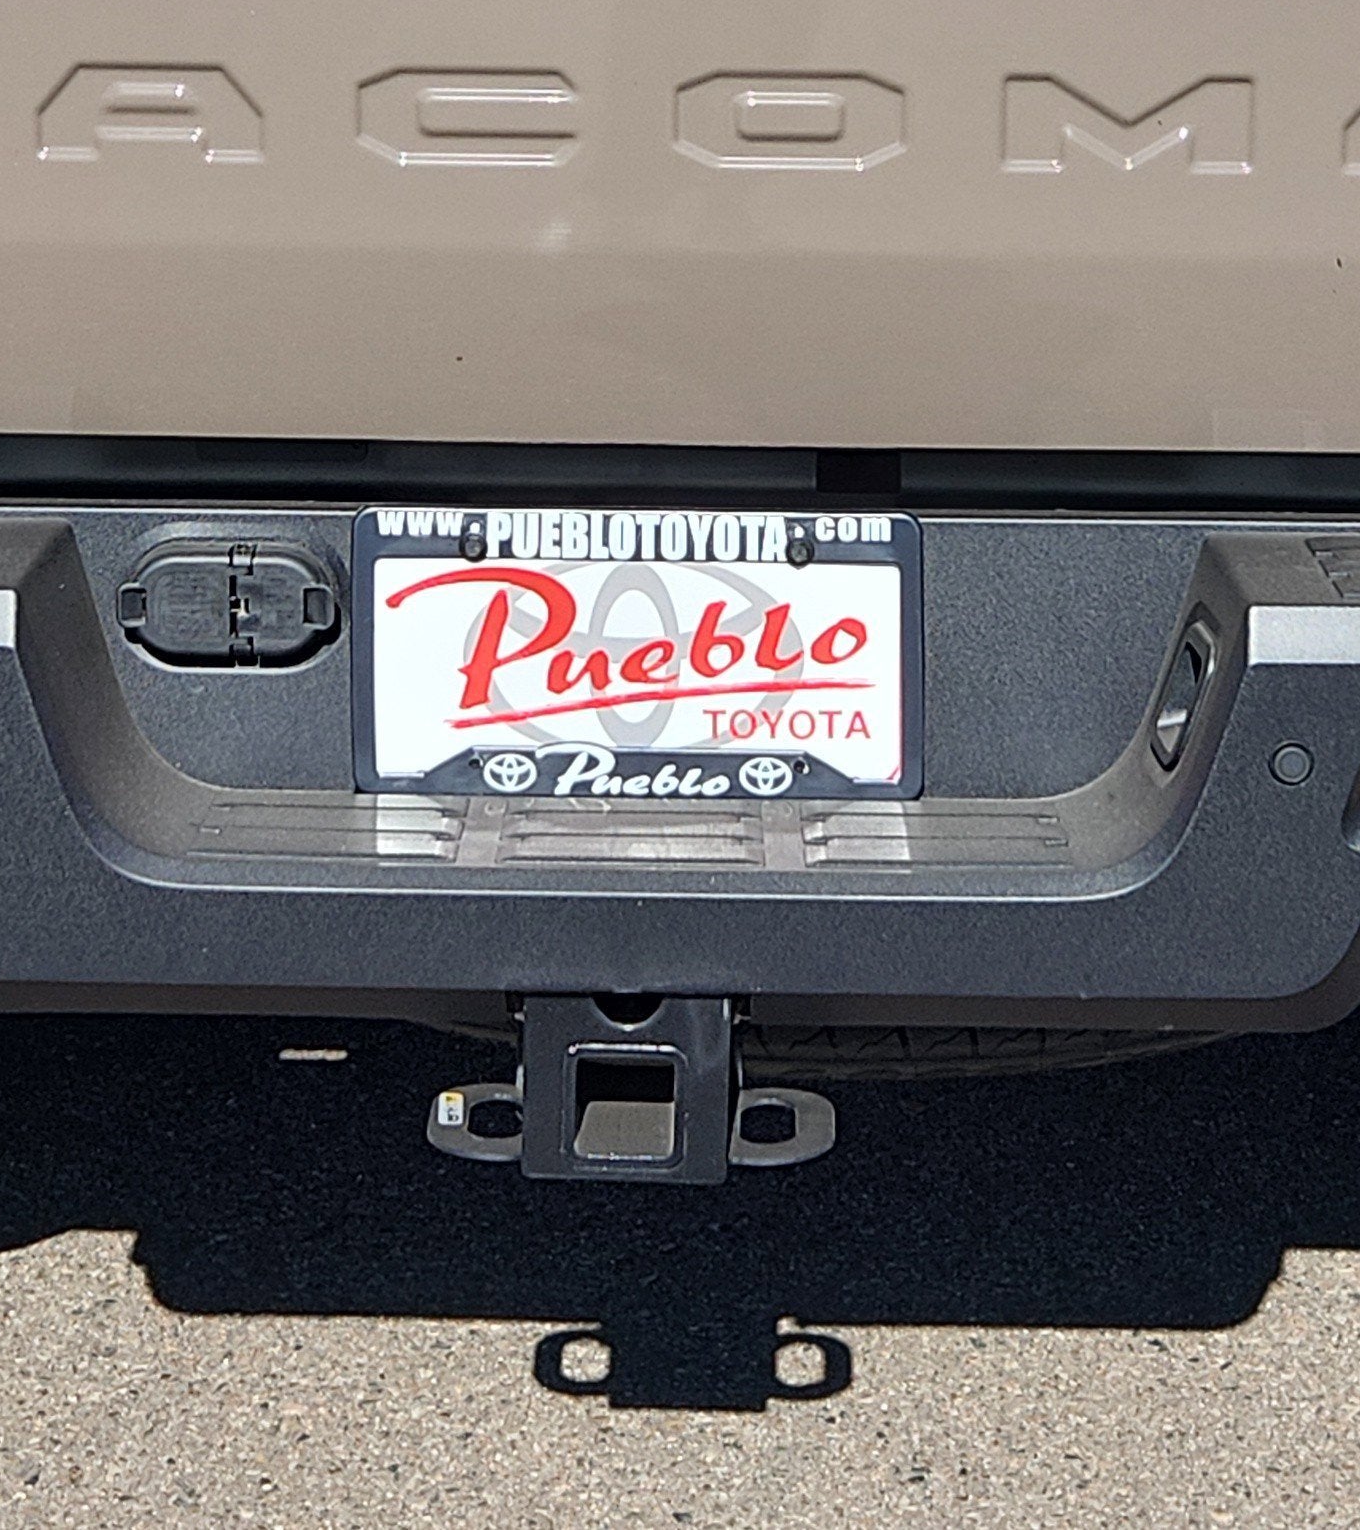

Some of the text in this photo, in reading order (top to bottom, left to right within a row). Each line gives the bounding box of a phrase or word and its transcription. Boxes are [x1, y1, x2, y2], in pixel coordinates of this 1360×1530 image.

[385, 566, 869, 709] Pueblo
[703, 709, 871, 740] TOYOTA
[535, 741, 731, 796] Pueblo
